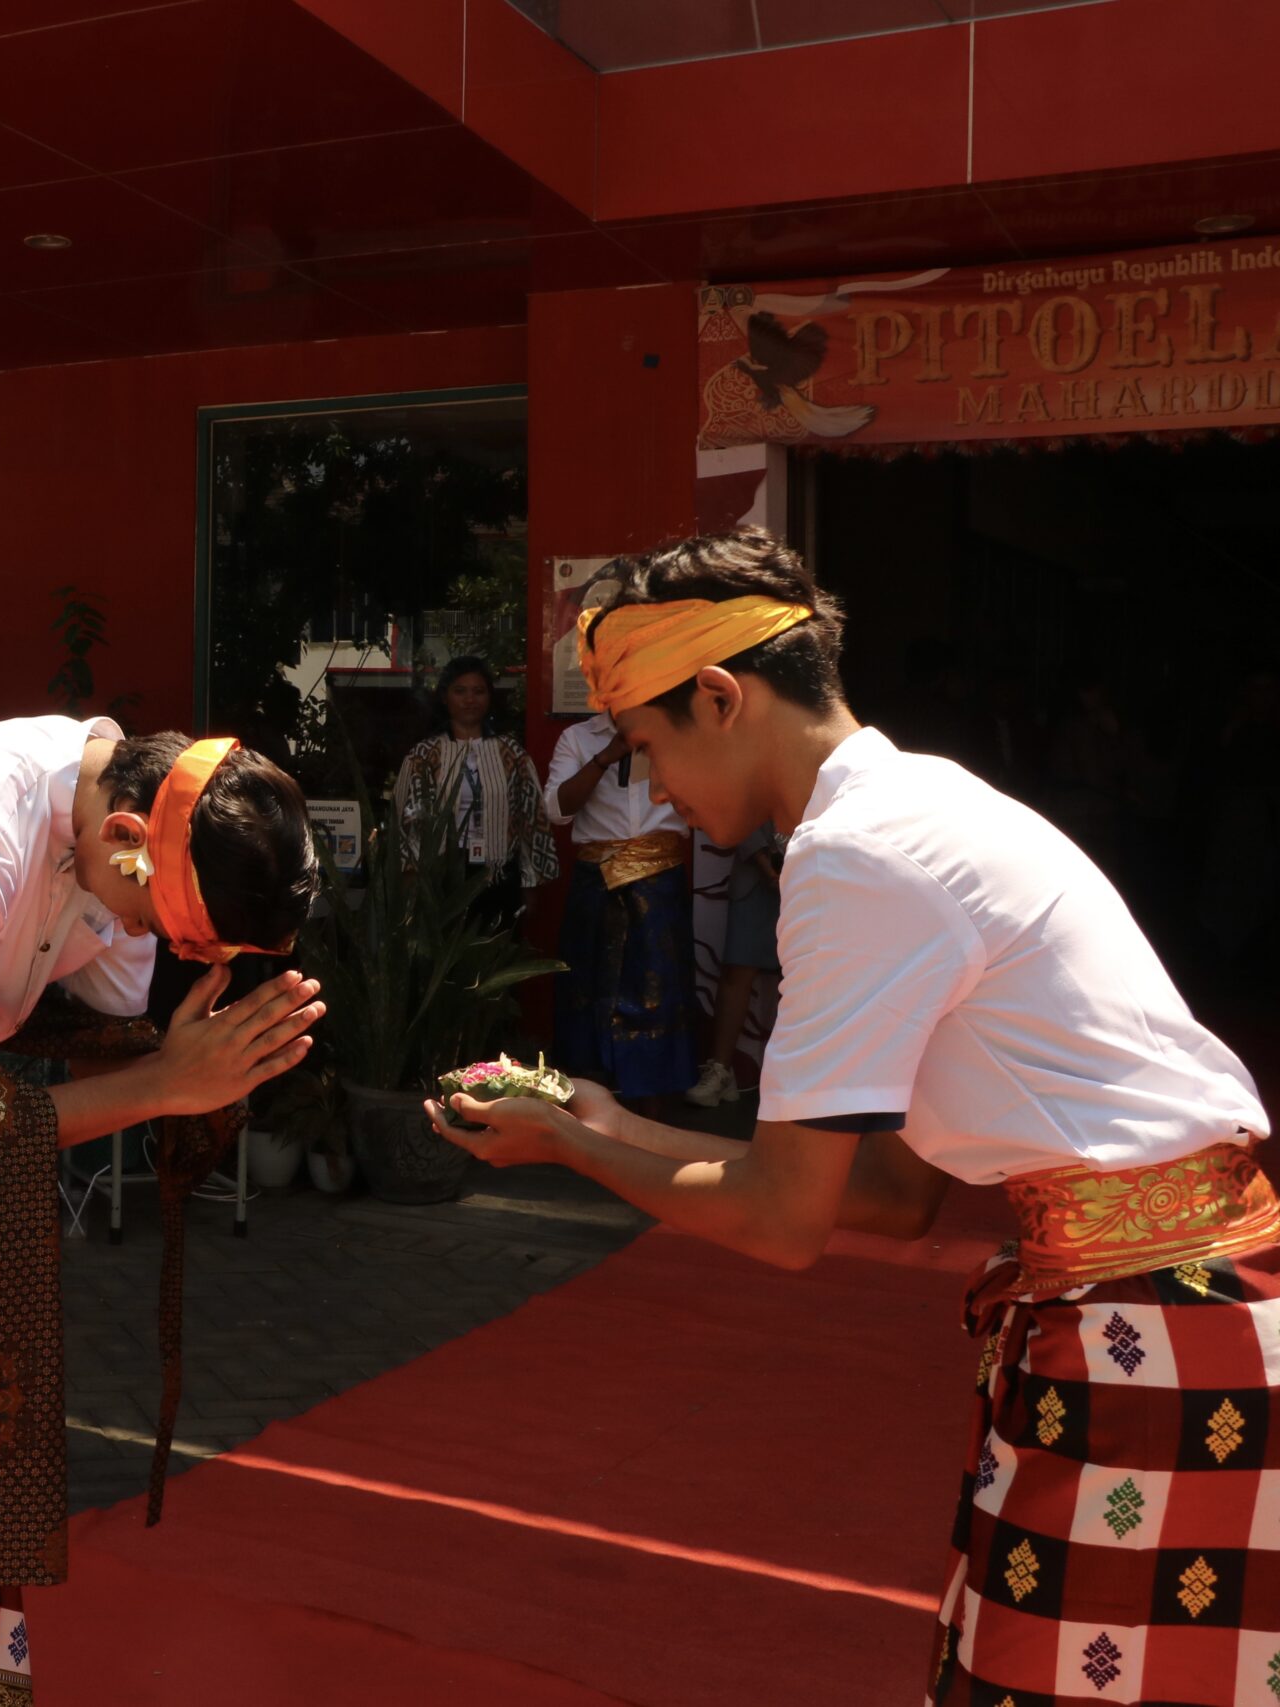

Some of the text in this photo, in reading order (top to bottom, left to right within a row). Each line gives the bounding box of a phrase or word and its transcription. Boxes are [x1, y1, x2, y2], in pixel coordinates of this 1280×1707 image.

[983, 267, 1106, 295] Dirgahayu
[1112, 251, 1222, 285] Republik
[848, 283, 1280, 386] PITOEL
